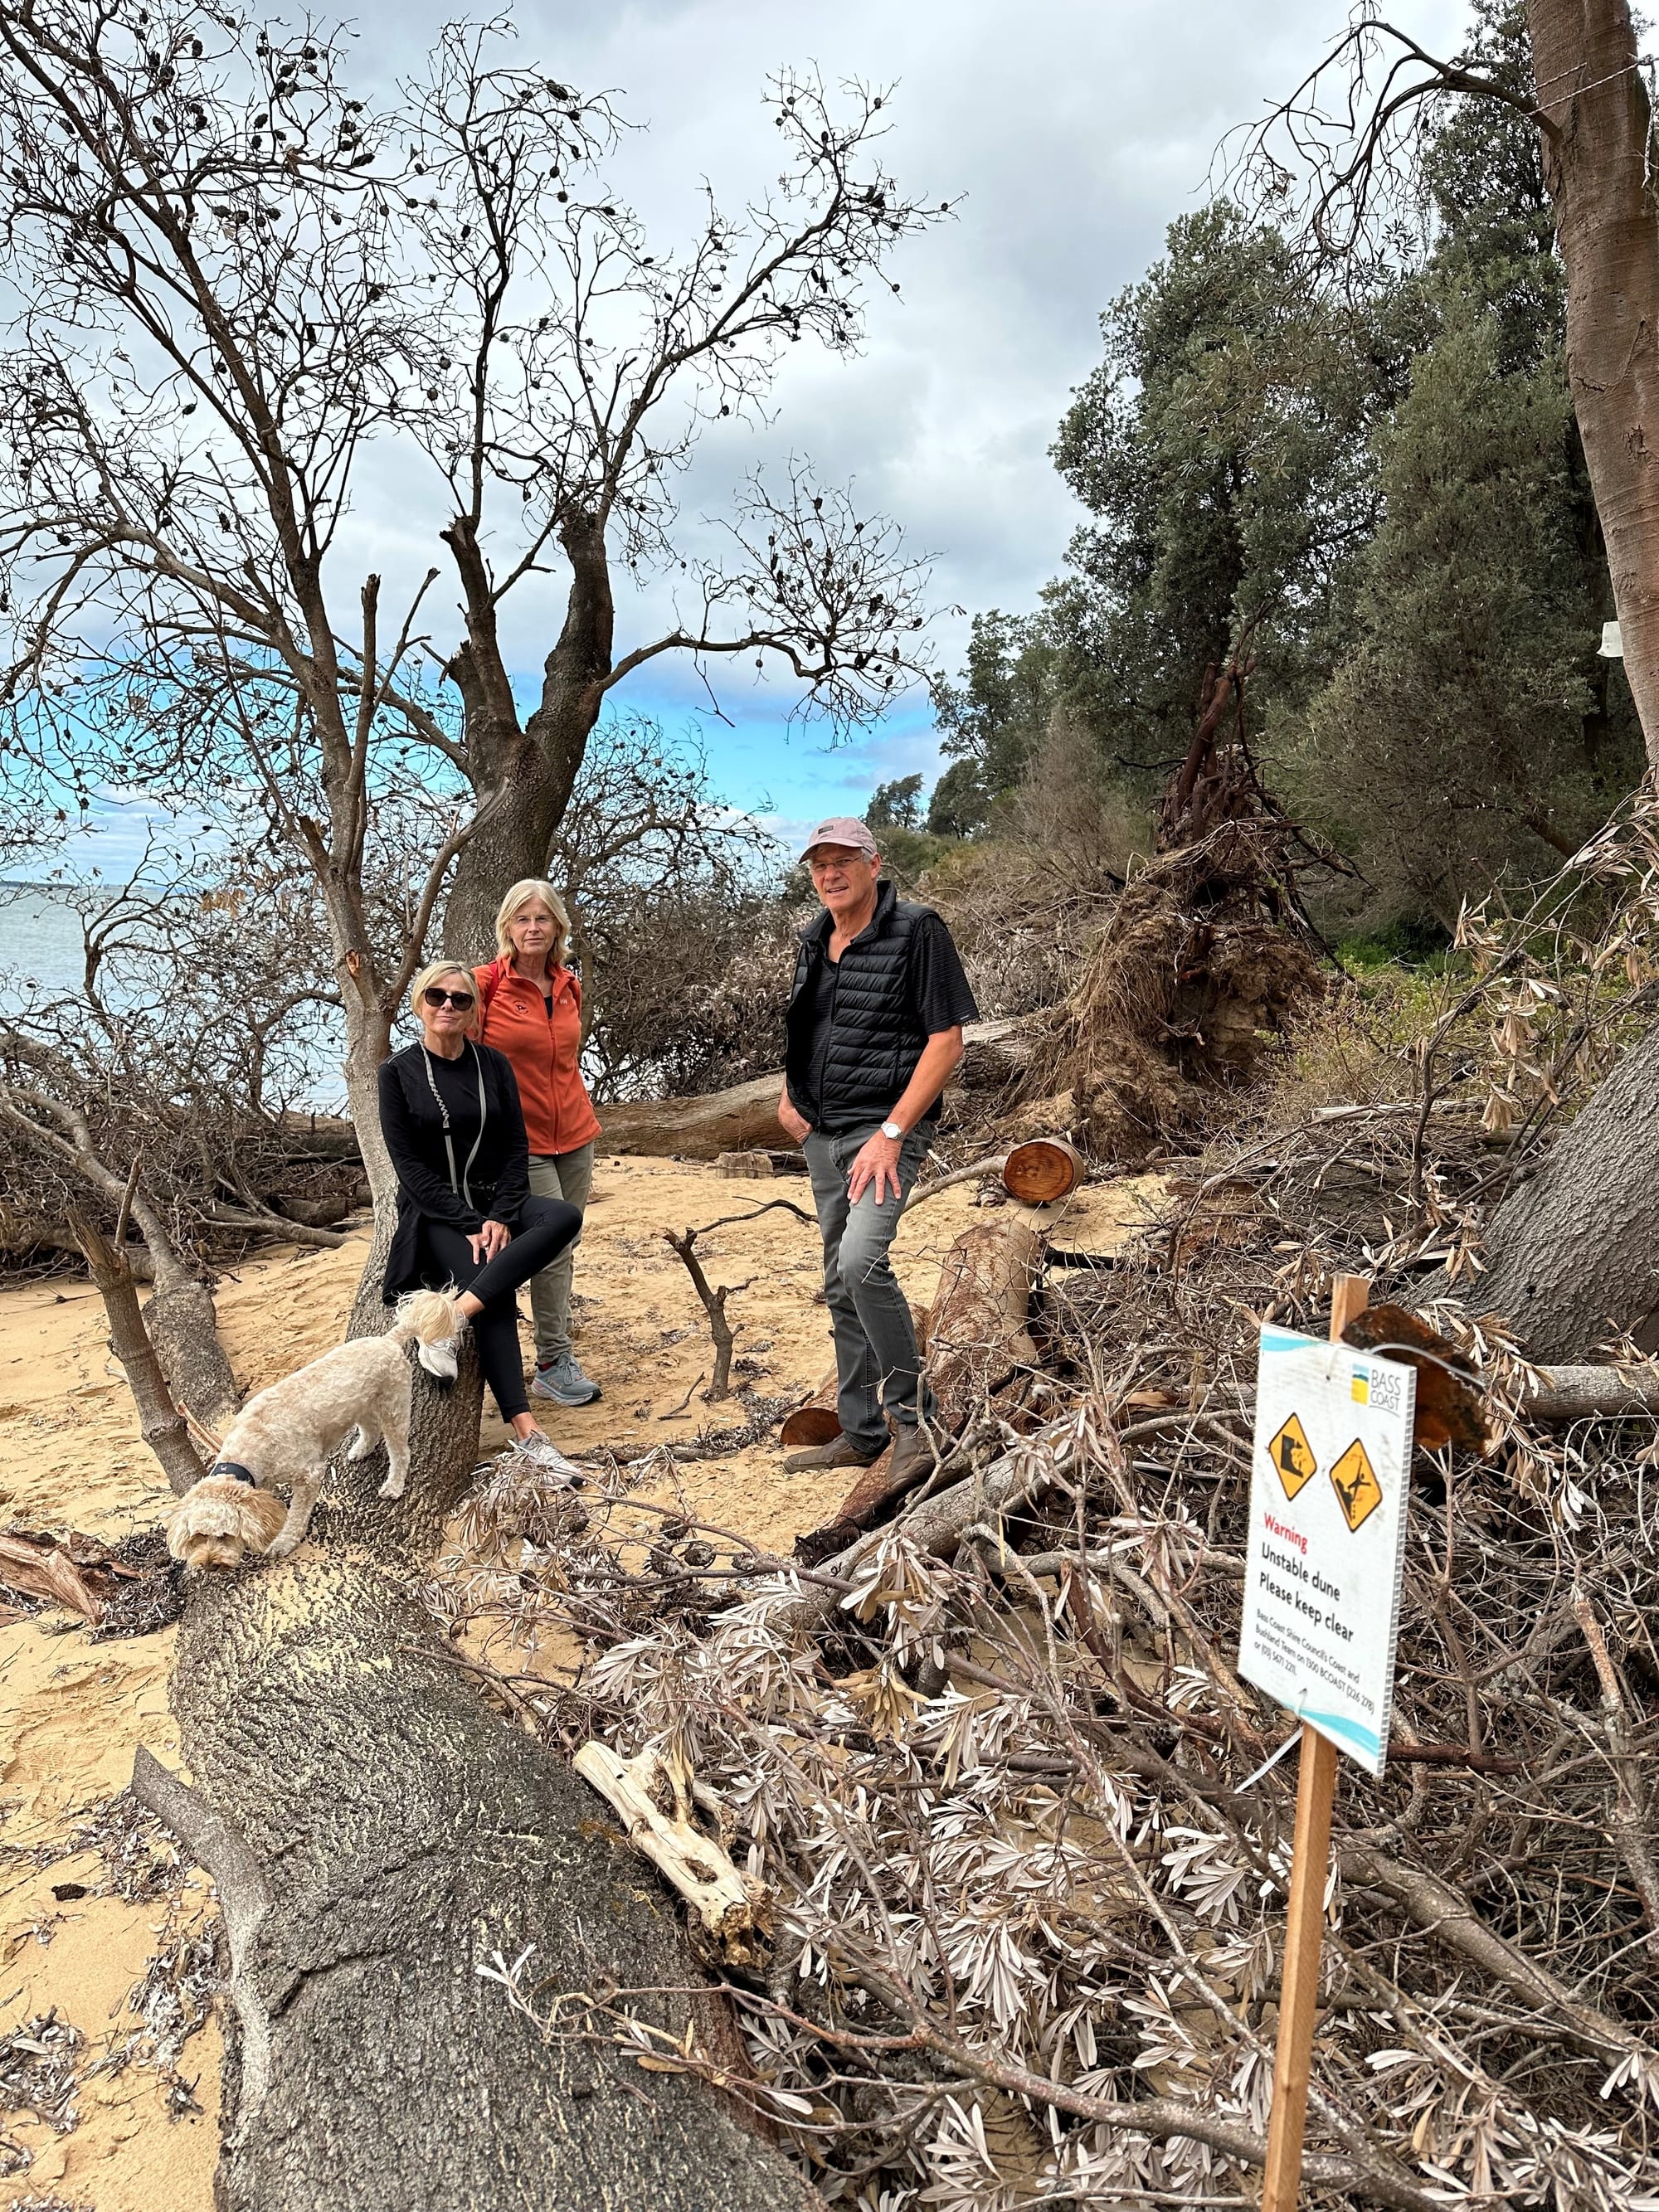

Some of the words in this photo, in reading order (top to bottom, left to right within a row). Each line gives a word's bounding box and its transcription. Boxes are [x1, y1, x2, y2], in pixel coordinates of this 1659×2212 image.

[1370, 1389, 1400, 1411] COAST
[1371, 1369, 1401, 1397] BASS
[1264, 1512, 1308, 1555] Warning
[1262, 1541, 1309, 1583] Unstable
[1311, 1570, 1340, 1602] dune
[1259, 1571, 1292, 1606] Please
[1295, 1590, 1322, 1627] keep
[1325, 1612, 1354, 1643] clear
[1254, 1641, 1261, 1650] or
[1256, 1623, 1281, 1647] Bushland
[1281, 1640, 1297, 1658] Team
[1297, 1653, 1305, 1665] on
[1306, 1656, 1319, 1674] 1300
[1320, 1666, 1346, 1693] BCOAST
[1257, 1608, 1268, 1623] Bass
[1269, 1616, 1285, 1635] Coast
[1286, 1627, 1301, 1645] Shire
[1329, 1655, 1347, 1675] Coast
[1347, 1670, 1360, 1684] and
